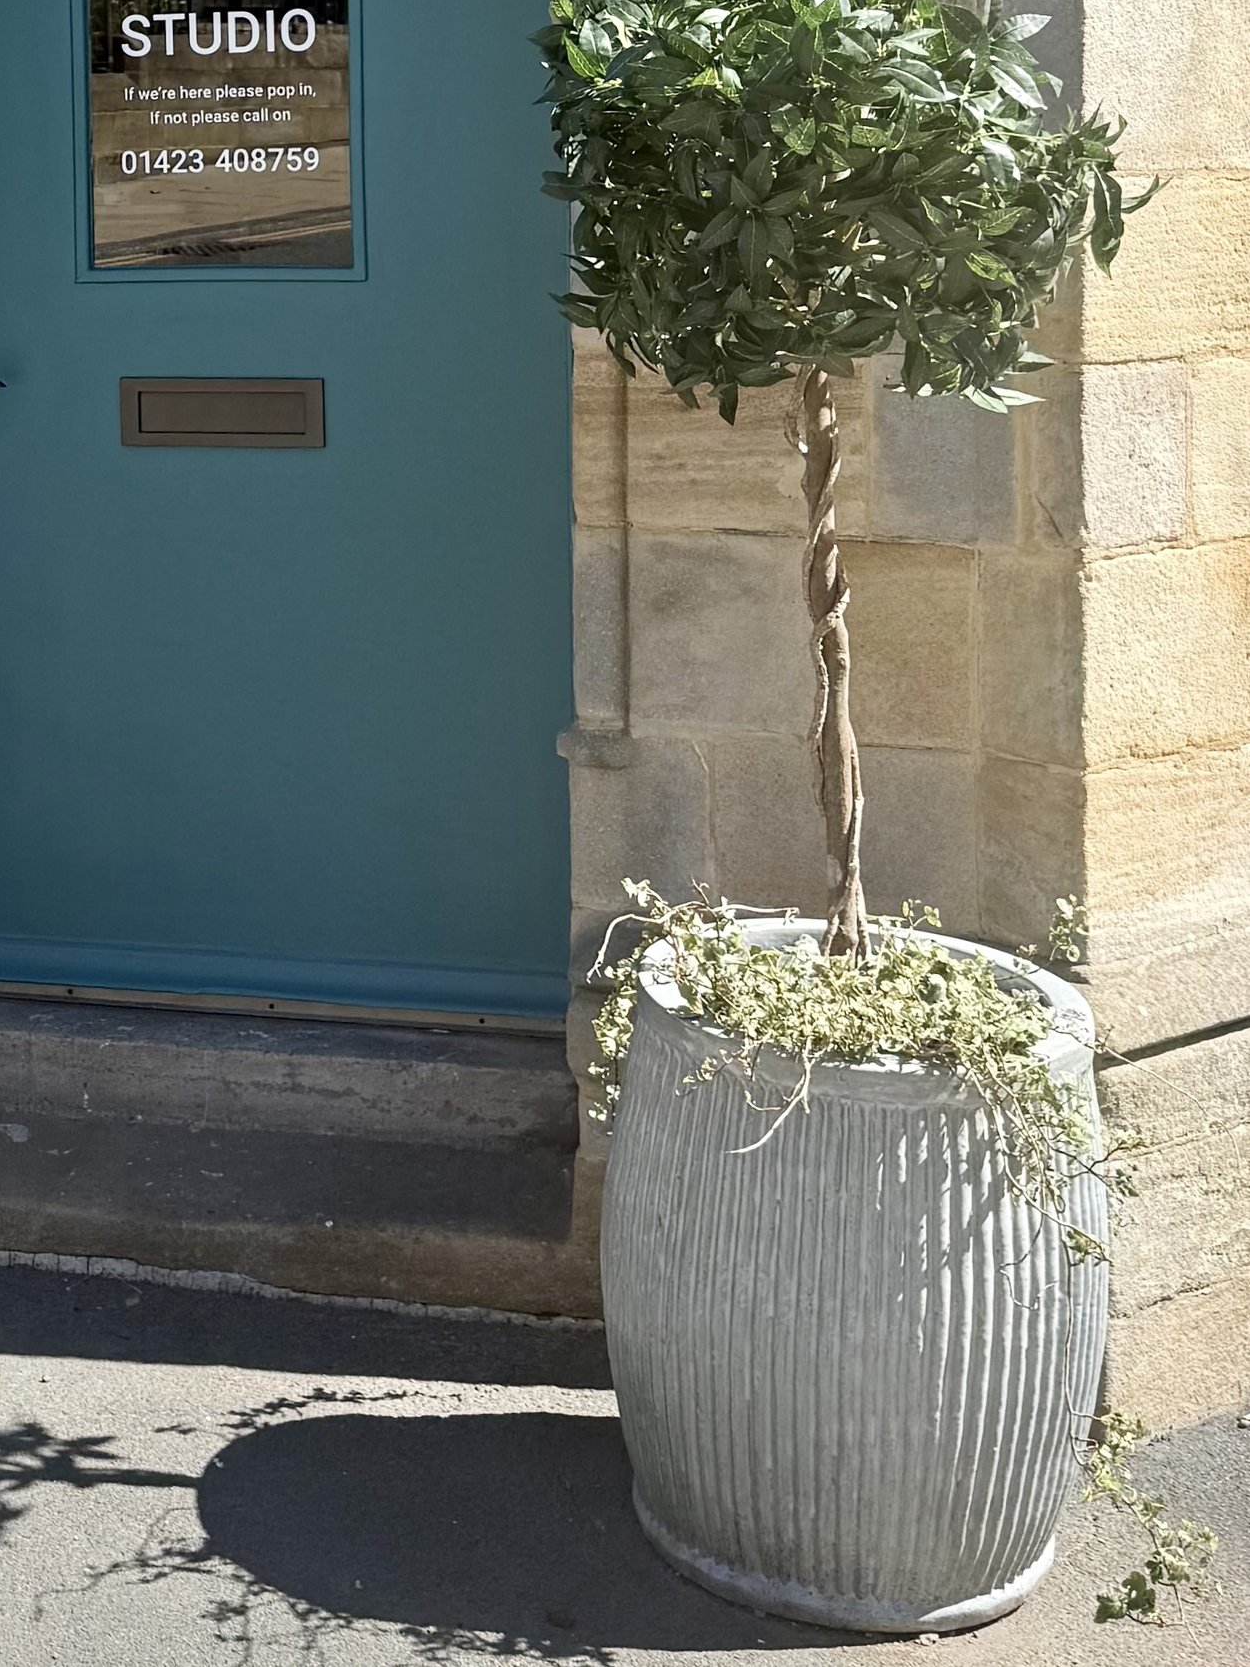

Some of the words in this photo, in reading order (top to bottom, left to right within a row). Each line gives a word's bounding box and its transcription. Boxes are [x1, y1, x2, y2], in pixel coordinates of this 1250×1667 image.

[121, 8, 317, 57] STUDIO
[124, 87, 135, 101] If
[138, 88, 176, 100] we're
[180, 86, 212, 99] here
[215, 84, 264, 101] please
[267, 85, 296, 100] pop
[299, 82, 317, 98] in,
[150, 111, 161, 125] If
[164, 112, 188, 124] not
[191, 109, 240, 127] please
[243, 107, 269, 122] call
[272, 109, 292, 121] on
[121, 149, 205, 175] 01423
[214, 147, 320, 174] 408759
